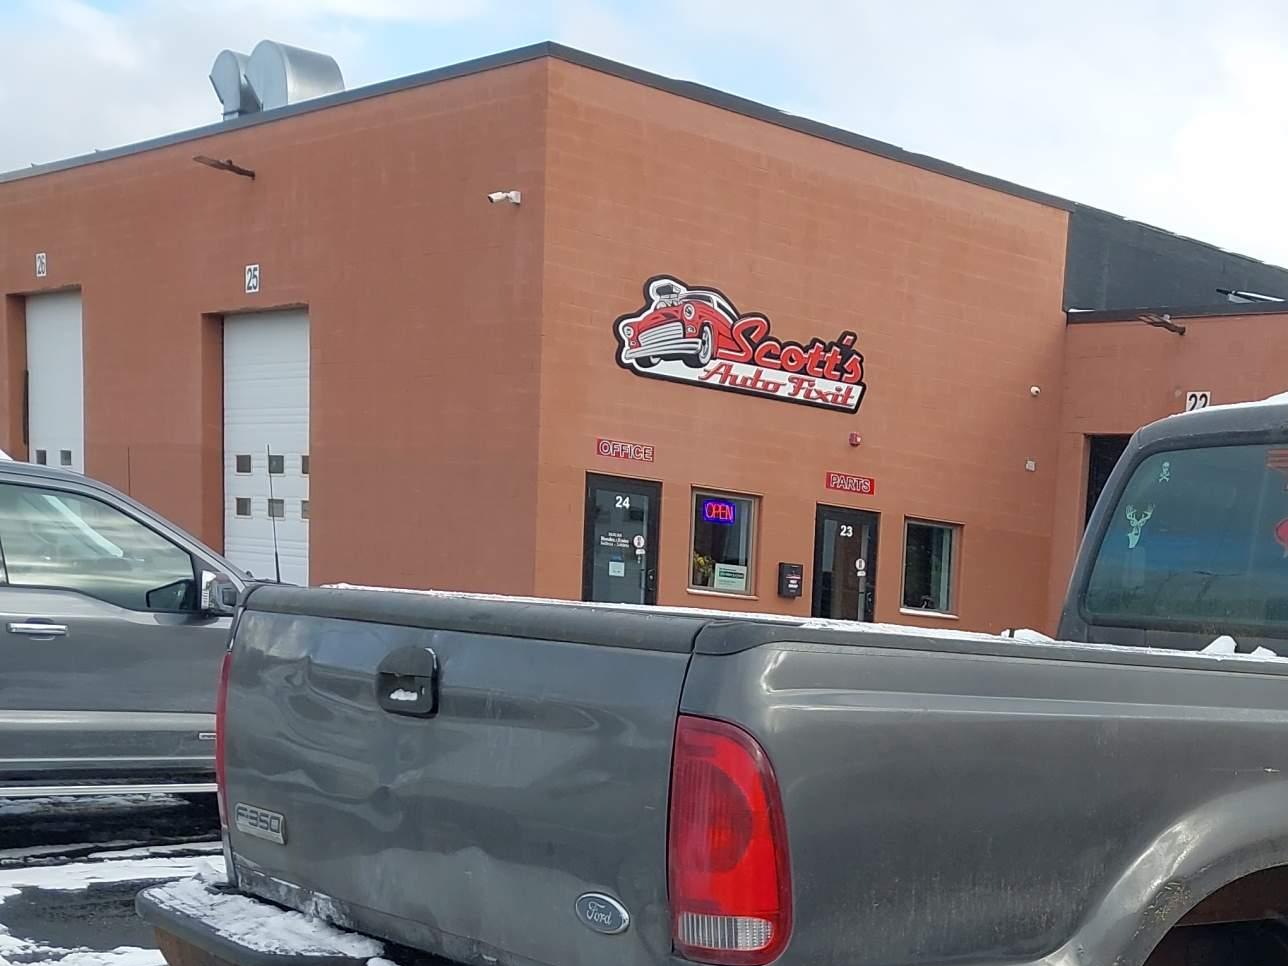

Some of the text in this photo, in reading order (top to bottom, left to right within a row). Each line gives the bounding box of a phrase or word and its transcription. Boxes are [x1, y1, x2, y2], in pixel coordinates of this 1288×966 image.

[37, 255, 46, 275] 26
[246, 267, 258, 290] 25
[717, 317, 863, 384] Scott's
[698, 361, 854, 407] Auto Fixit
[1188, 394, 1208, 410] 22
[599, 440, 653, 461] OFFICE
[829, 475, 871, 493] PARTS
[615, 495, 631, 509] 24
[705, 501, 734, 522] OPEN
[840, 525, 853, 537] 23
[586, 901, 613, 926] Ford
